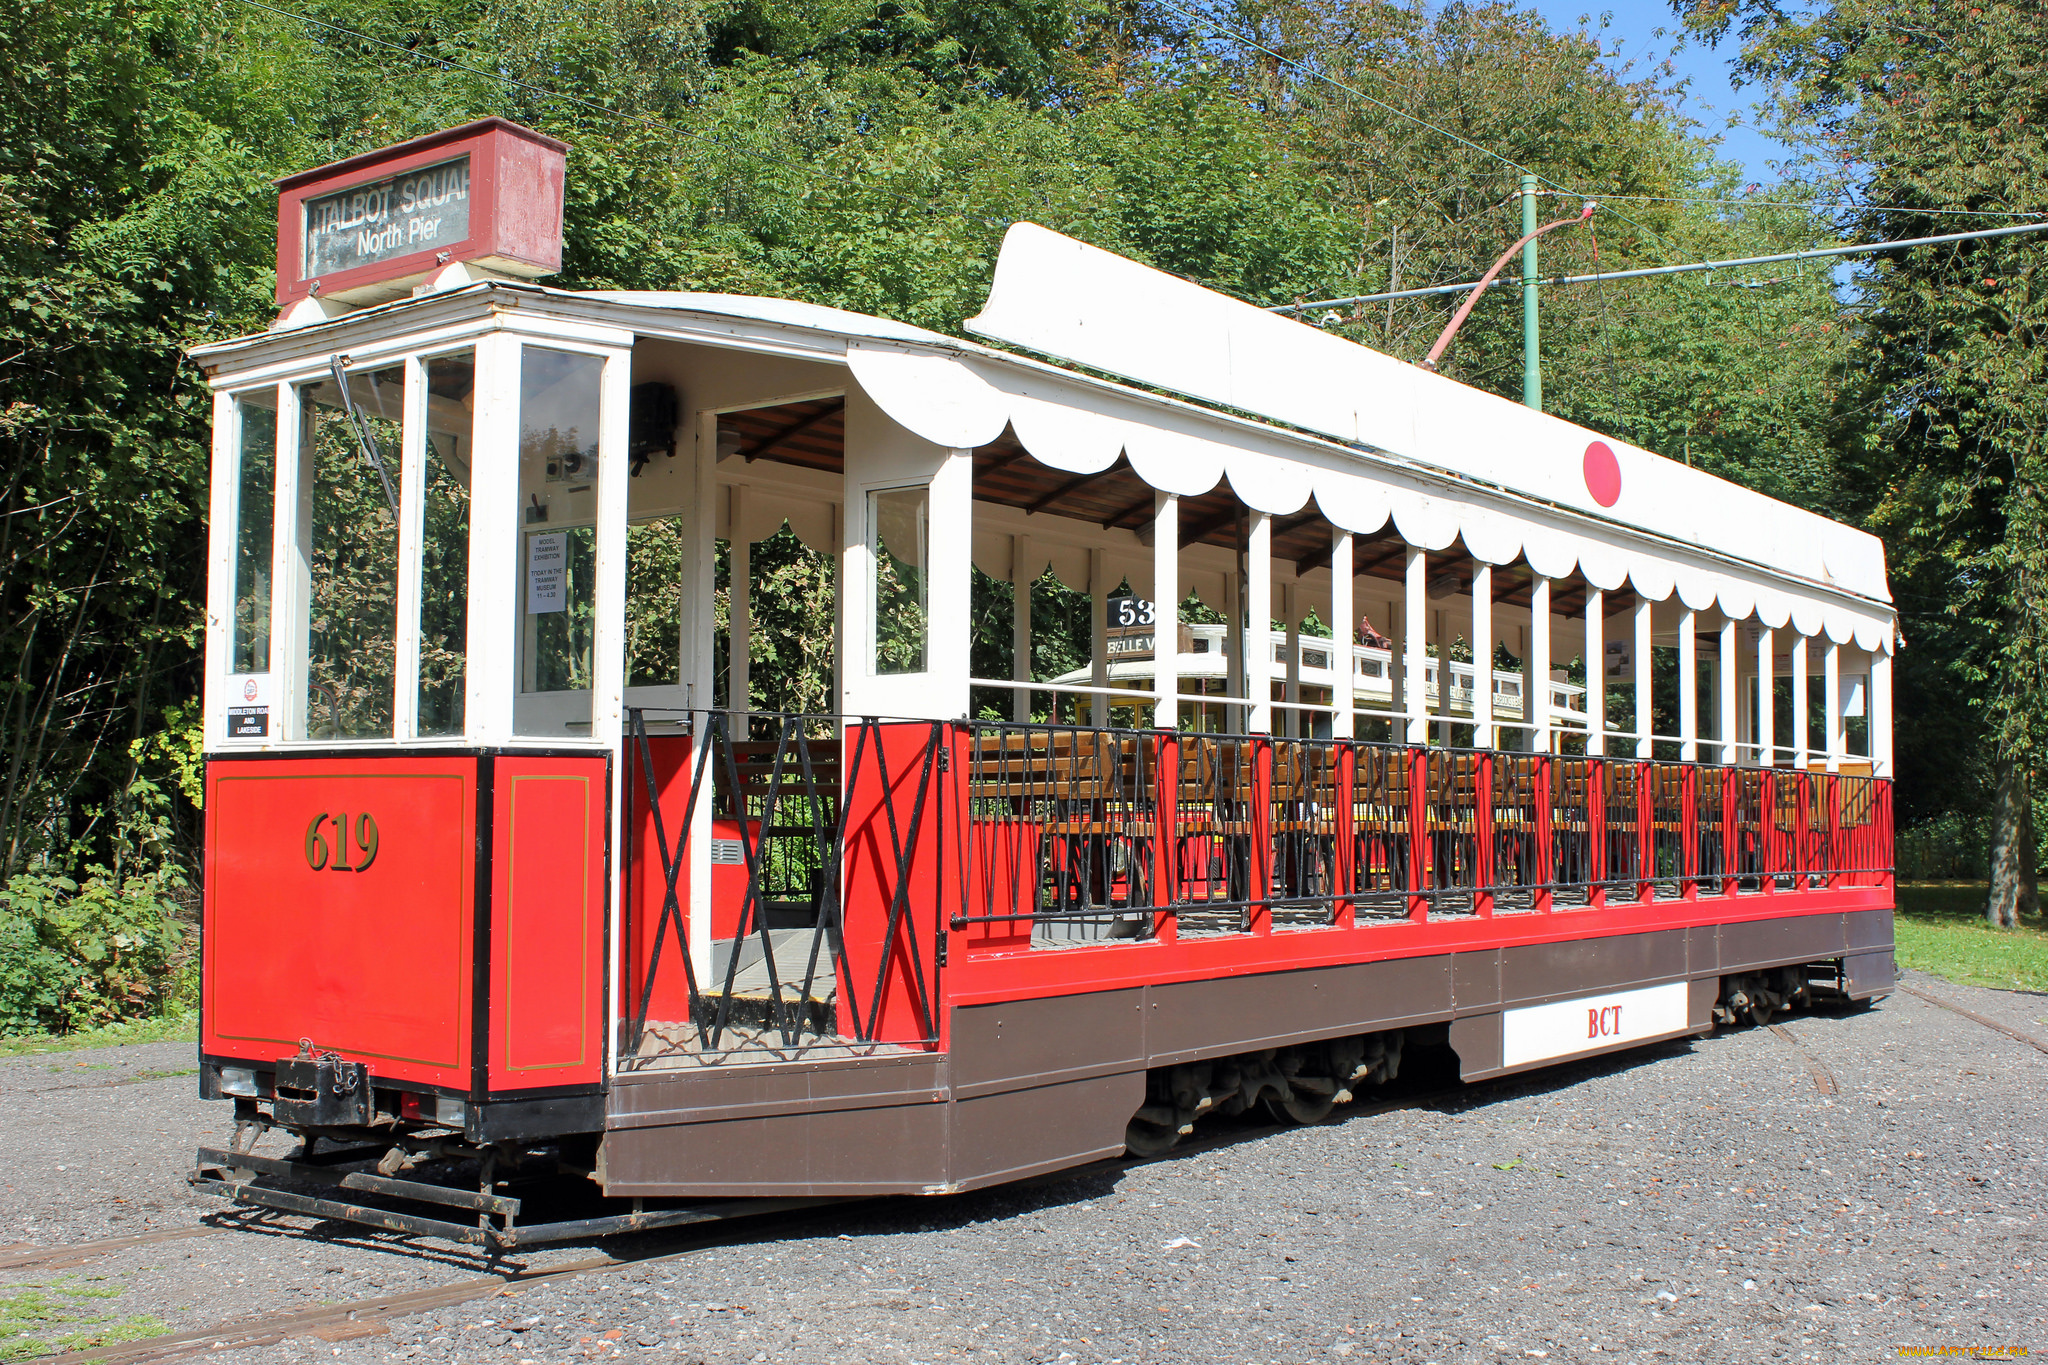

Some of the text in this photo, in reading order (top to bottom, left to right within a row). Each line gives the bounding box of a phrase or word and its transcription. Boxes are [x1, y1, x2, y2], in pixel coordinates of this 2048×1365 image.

[318, 184, 394, 235] TALBOT
[356, 216, 442, 257] North Pier
[534, 553, 561, 561] EXHIBITION
[536, 584, 557, 592] MUSEUM
[1119, 599, 1156, 626] 53
[1107, 638, 1144, 654] BELLE
[256, 707, 269, 715] ROA
[243, 717, 255, 725] AND
[236, 726, 262, 734] LAKESIDE
[305, 812, 379, 873] 619
[1587, 1005, 1623, 1039] BCT
